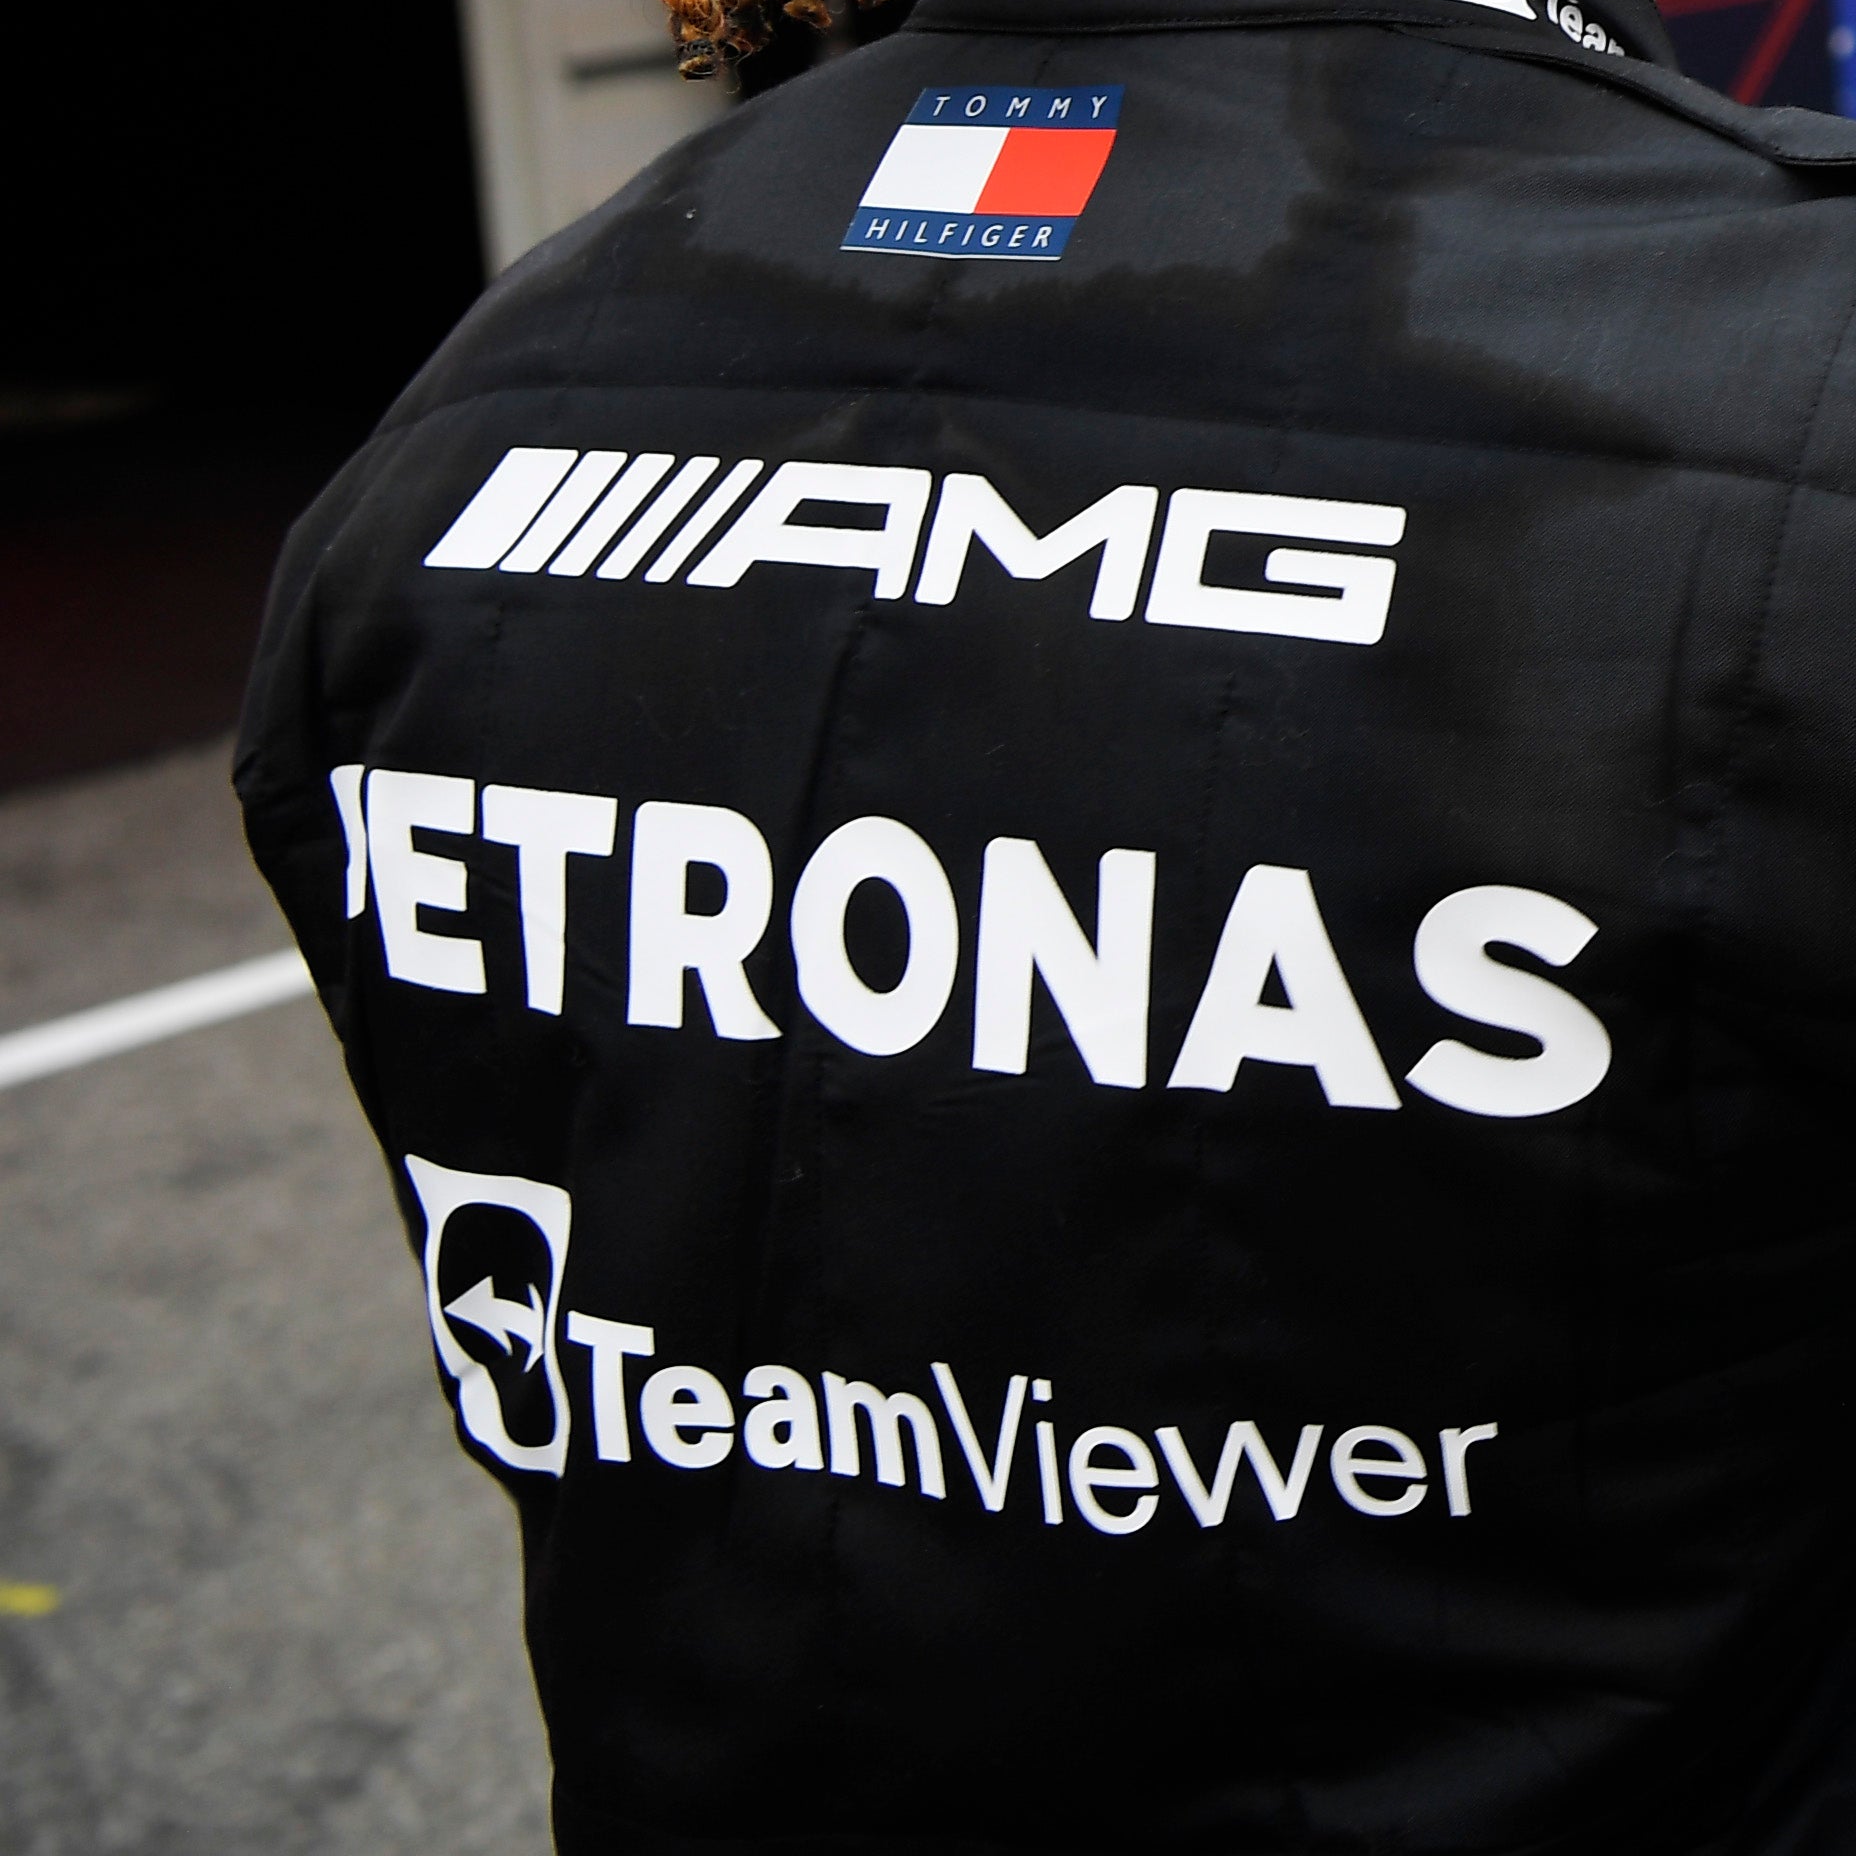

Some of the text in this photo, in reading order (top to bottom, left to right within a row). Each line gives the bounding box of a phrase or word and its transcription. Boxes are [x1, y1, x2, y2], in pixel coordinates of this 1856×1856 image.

[931, 94, 1108, 120] TOMMY
[864, 216, 1054, 249] HILFIGER
[686, 456, 1407, 645] AMG
[567, 1309, 1499, 1536] TeamViewer
